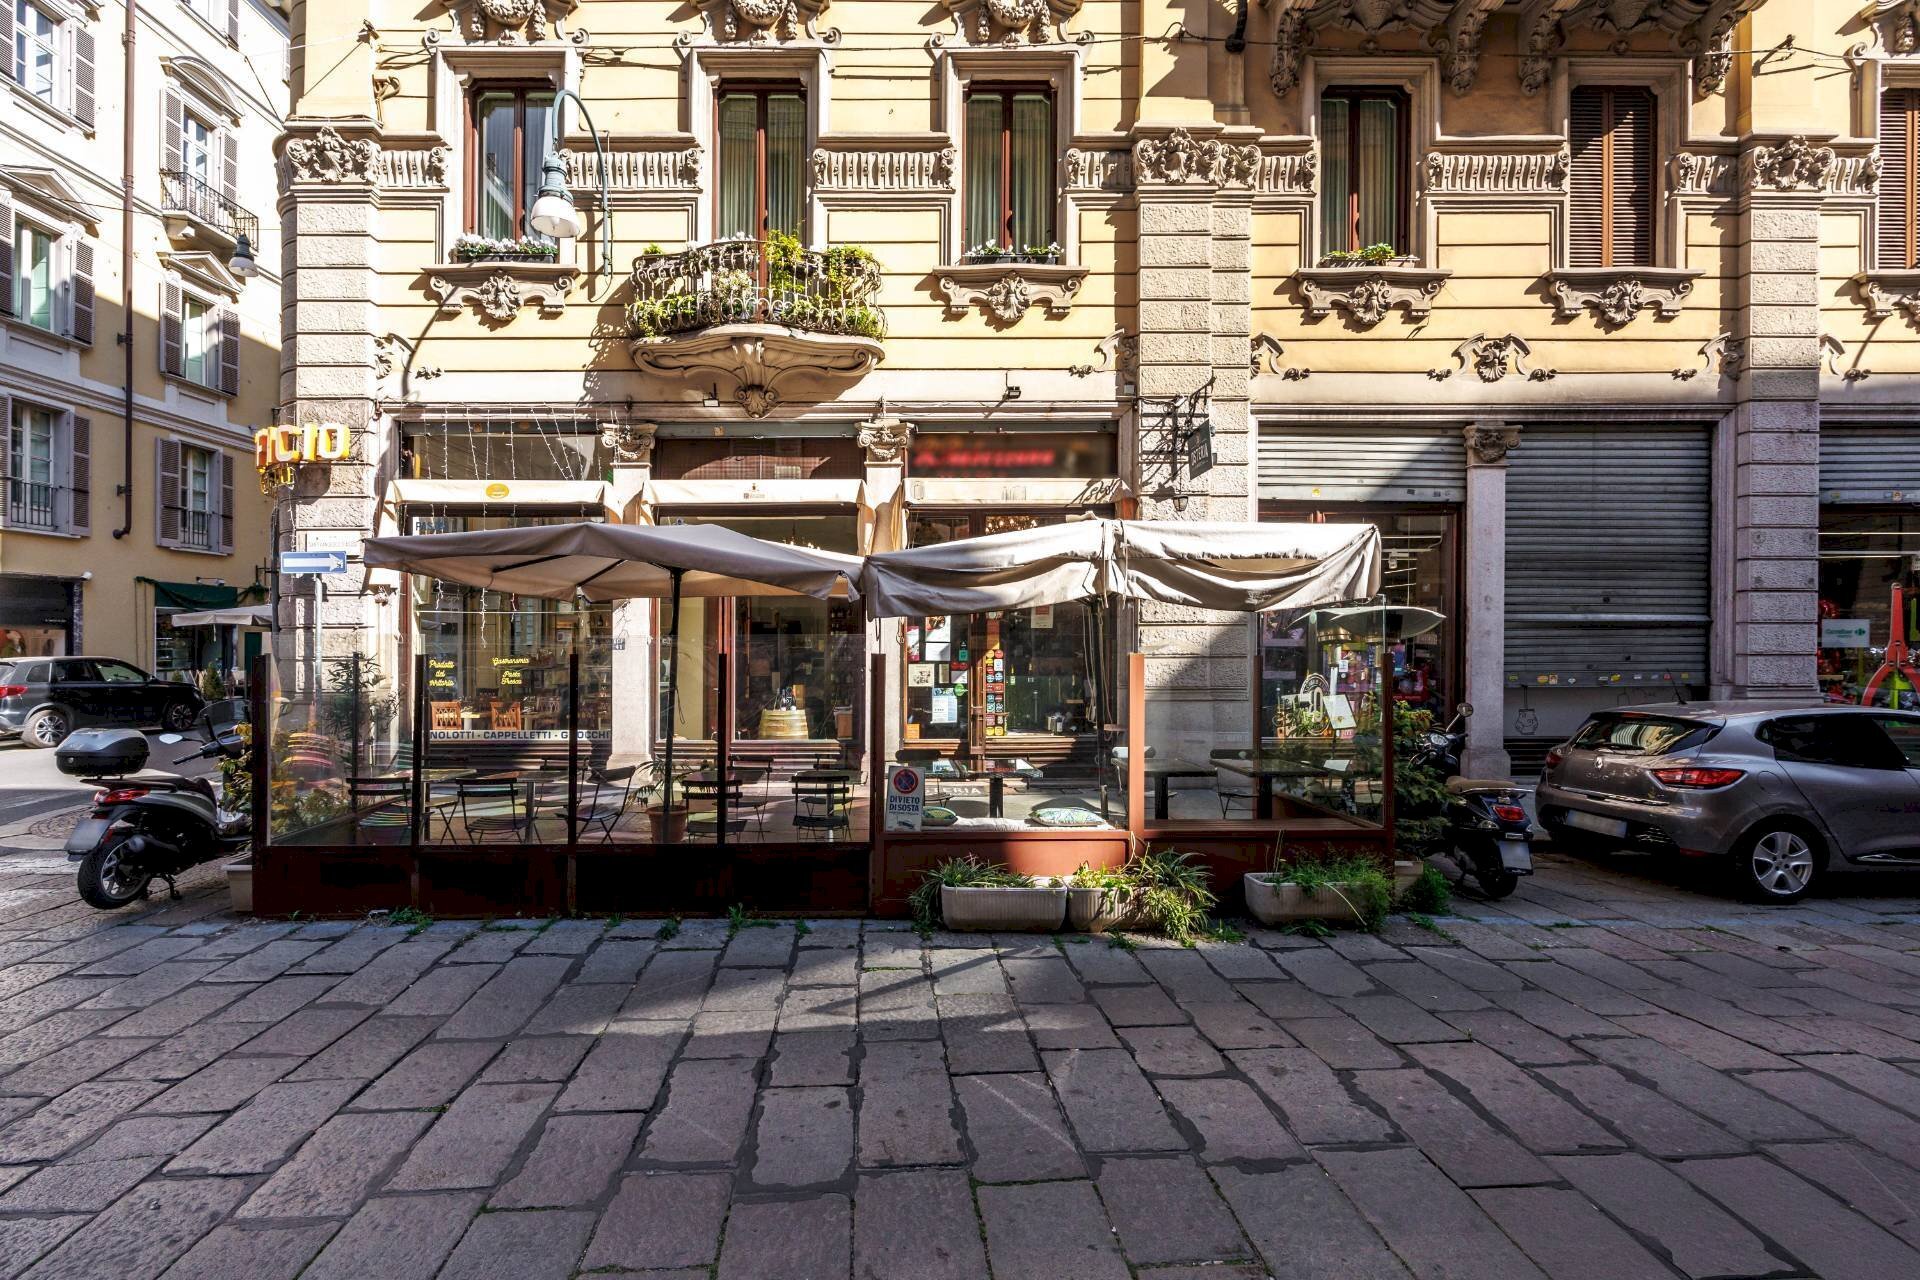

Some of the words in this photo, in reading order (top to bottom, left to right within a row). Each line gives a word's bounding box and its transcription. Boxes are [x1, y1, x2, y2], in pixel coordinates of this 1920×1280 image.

[483, 731, 551, 739] CAPPELLETTI
[561, 731, 609, 739] GOCCHI
[890, 795, 920, 804] DIVIETO
[897, 804, 920, 812] SOSTA
